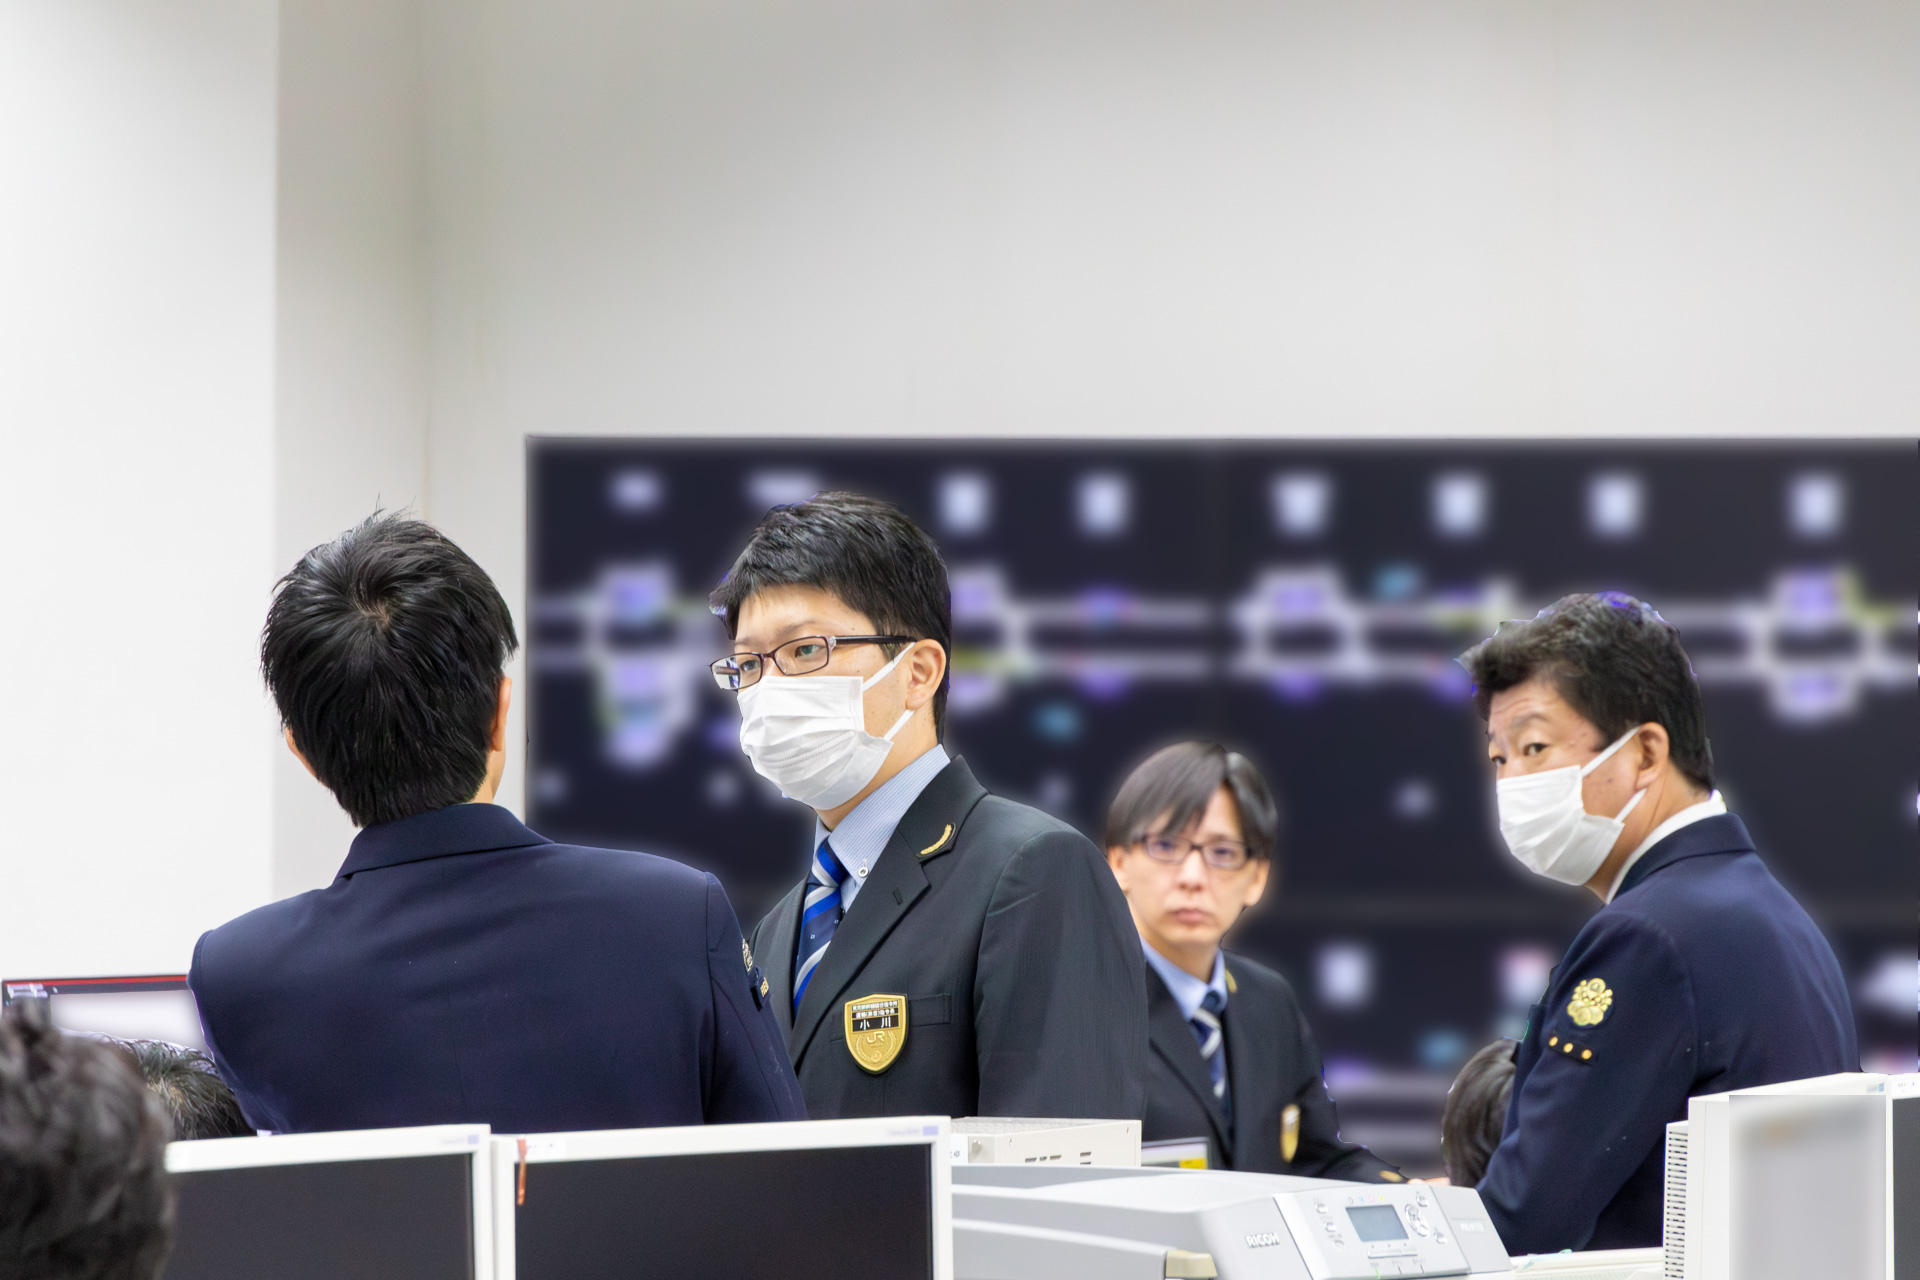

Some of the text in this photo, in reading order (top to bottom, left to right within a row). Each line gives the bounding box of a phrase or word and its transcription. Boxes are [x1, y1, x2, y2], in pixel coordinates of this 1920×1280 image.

[860, 1016, 891, 1031] 小川
[866, 1031, 885, 1044] JR
[1245, 1232, 1280, 1248] RICOH
